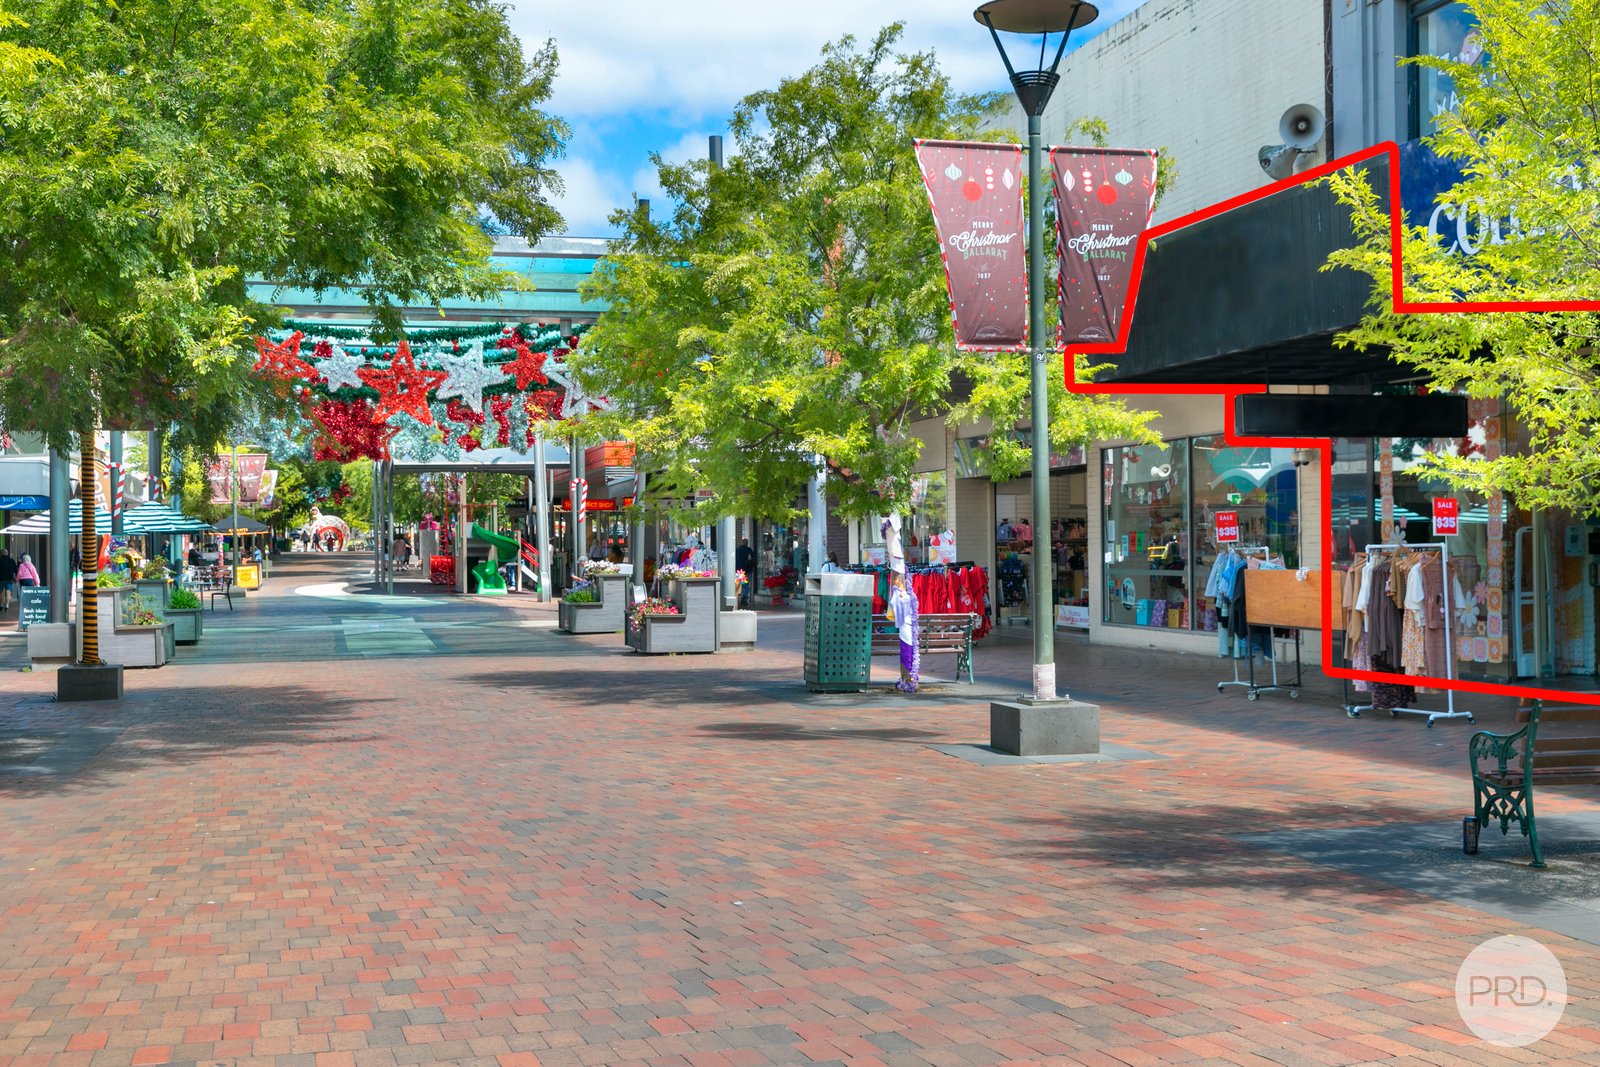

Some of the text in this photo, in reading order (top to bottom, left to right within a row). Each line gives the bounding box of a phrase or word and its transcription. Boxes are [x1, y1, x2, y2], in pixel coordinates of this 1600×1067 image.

[972, 221, 994, 229] MERRY
[1092, 223, 1114, 232] MERRY
[949, 230, 1017, 252] Christmas
[1068, 232, 1137, 255] Christmas
[963, 247, 1007, 260] BALLARAT
[1083, 249, 1127, 263] BALLARAT
[1437, 517, 1456, 528] $35
[1219, 527, 1236, 536] $35
